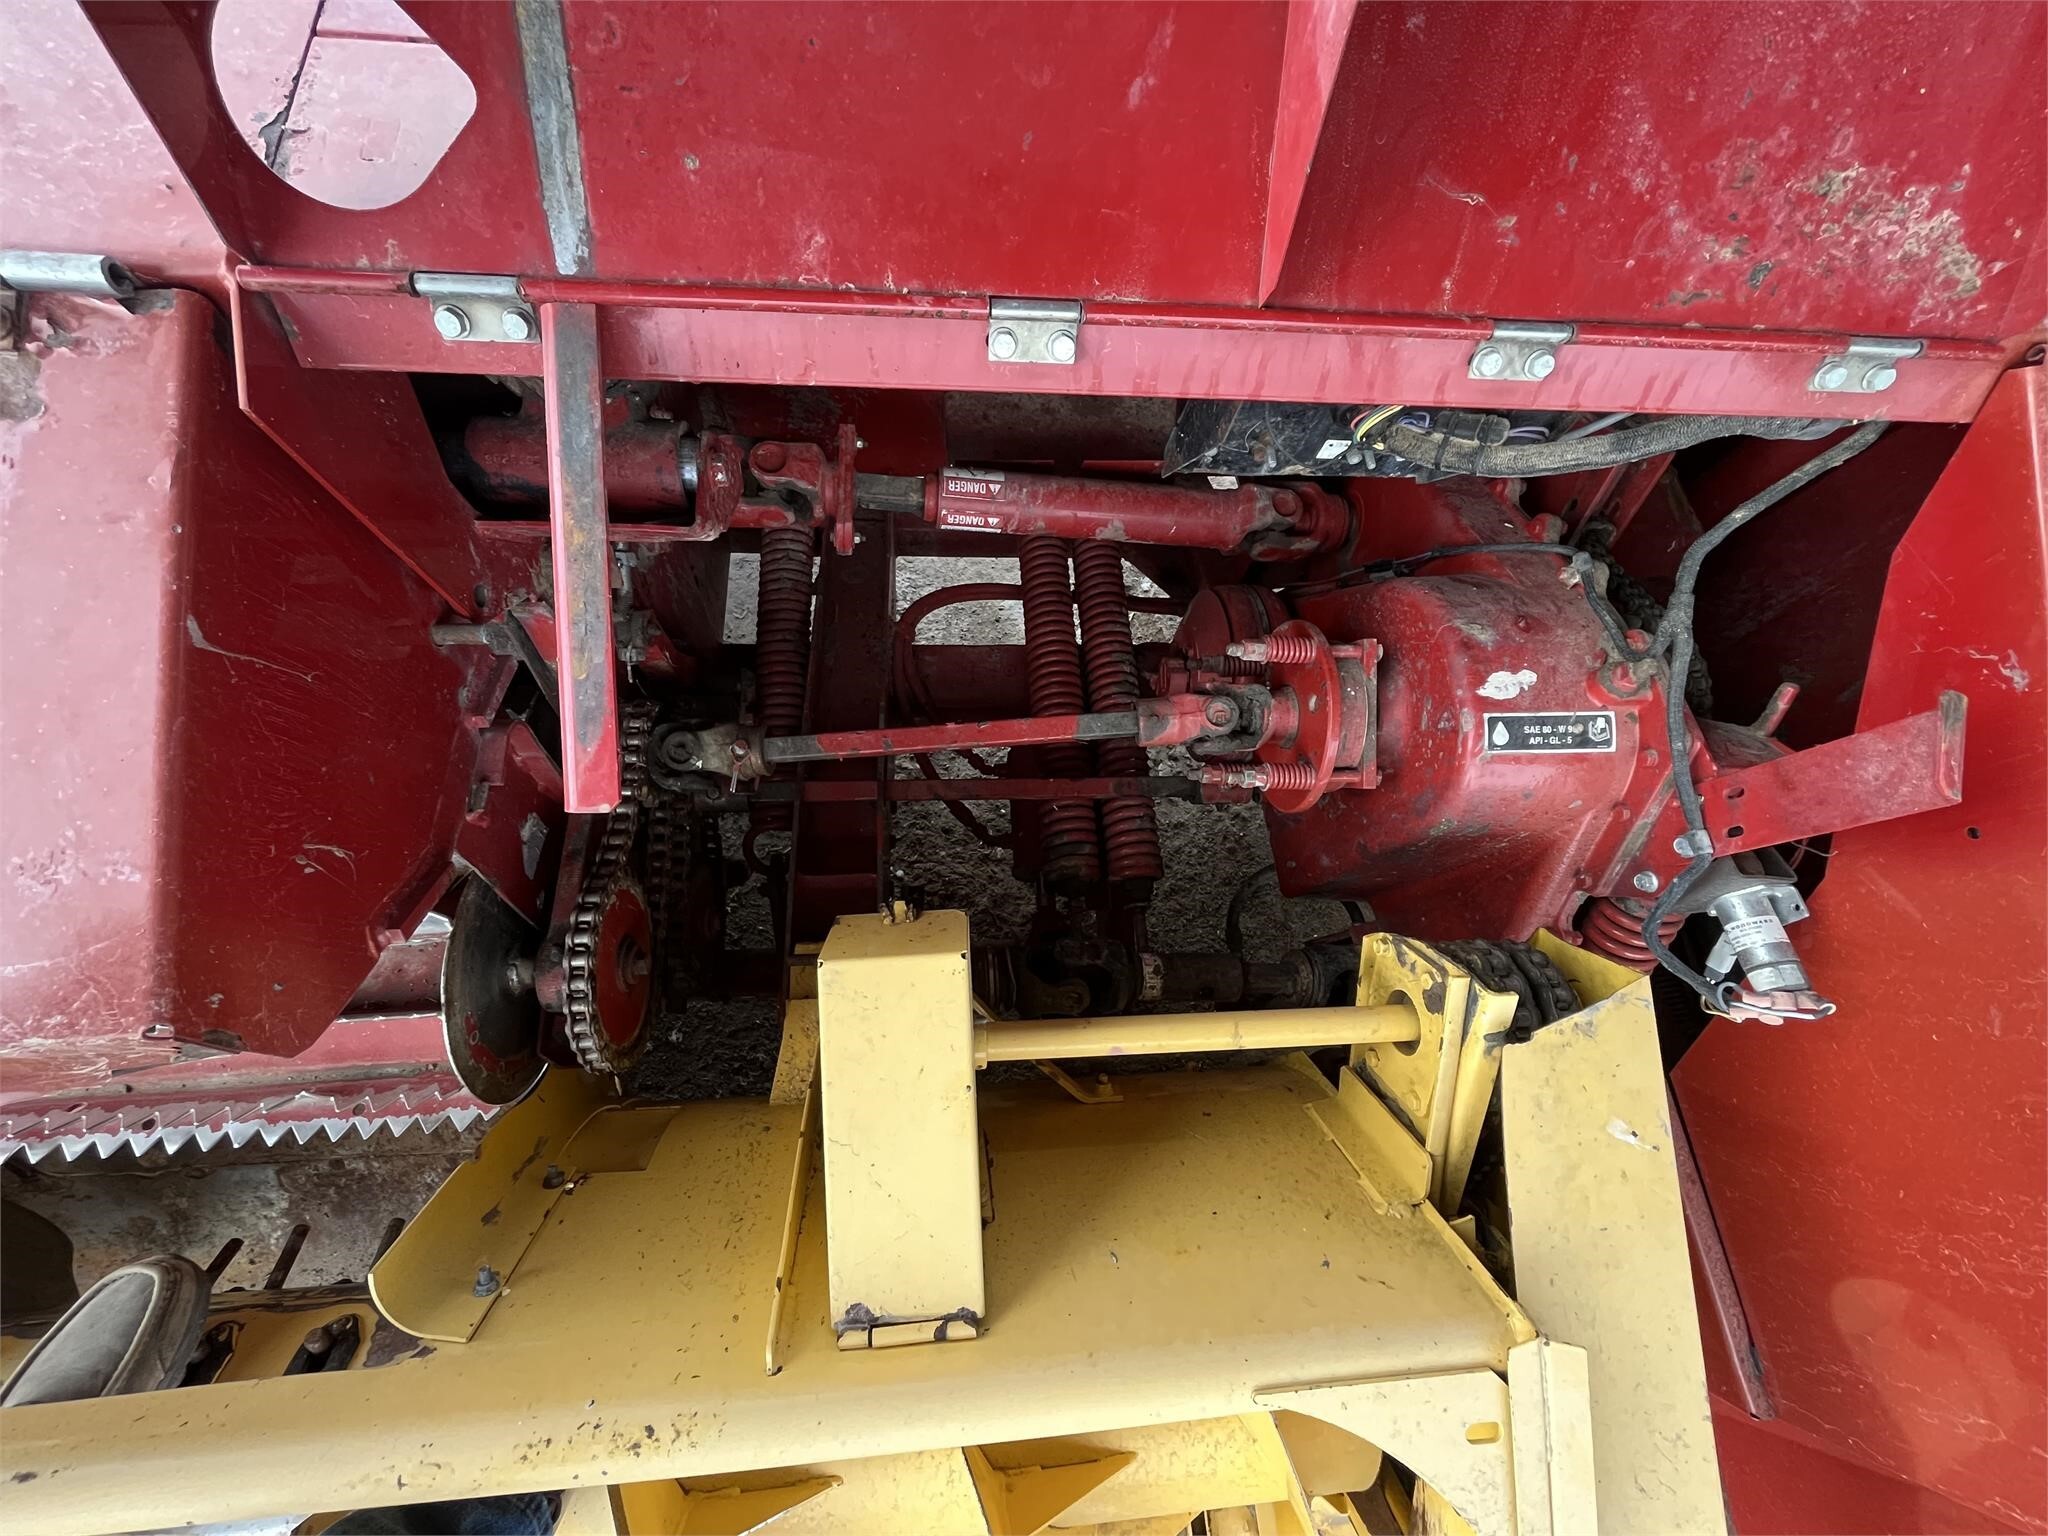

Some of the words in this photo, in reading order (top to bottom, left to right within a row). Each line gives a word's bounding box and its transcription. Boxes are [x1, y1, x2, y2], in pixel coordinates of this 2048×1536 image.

[948, 480, 986, 494] DANGER
[947, 514, 985, 525] DANGER
[1524, 725, 1540, 734] SAE
[1542, 725, 1552, 734] 80
[1558, 725, 1567, 733] W
[1529, 737, 1543, 745] API
[1567, 736, 1573, 744] 5
